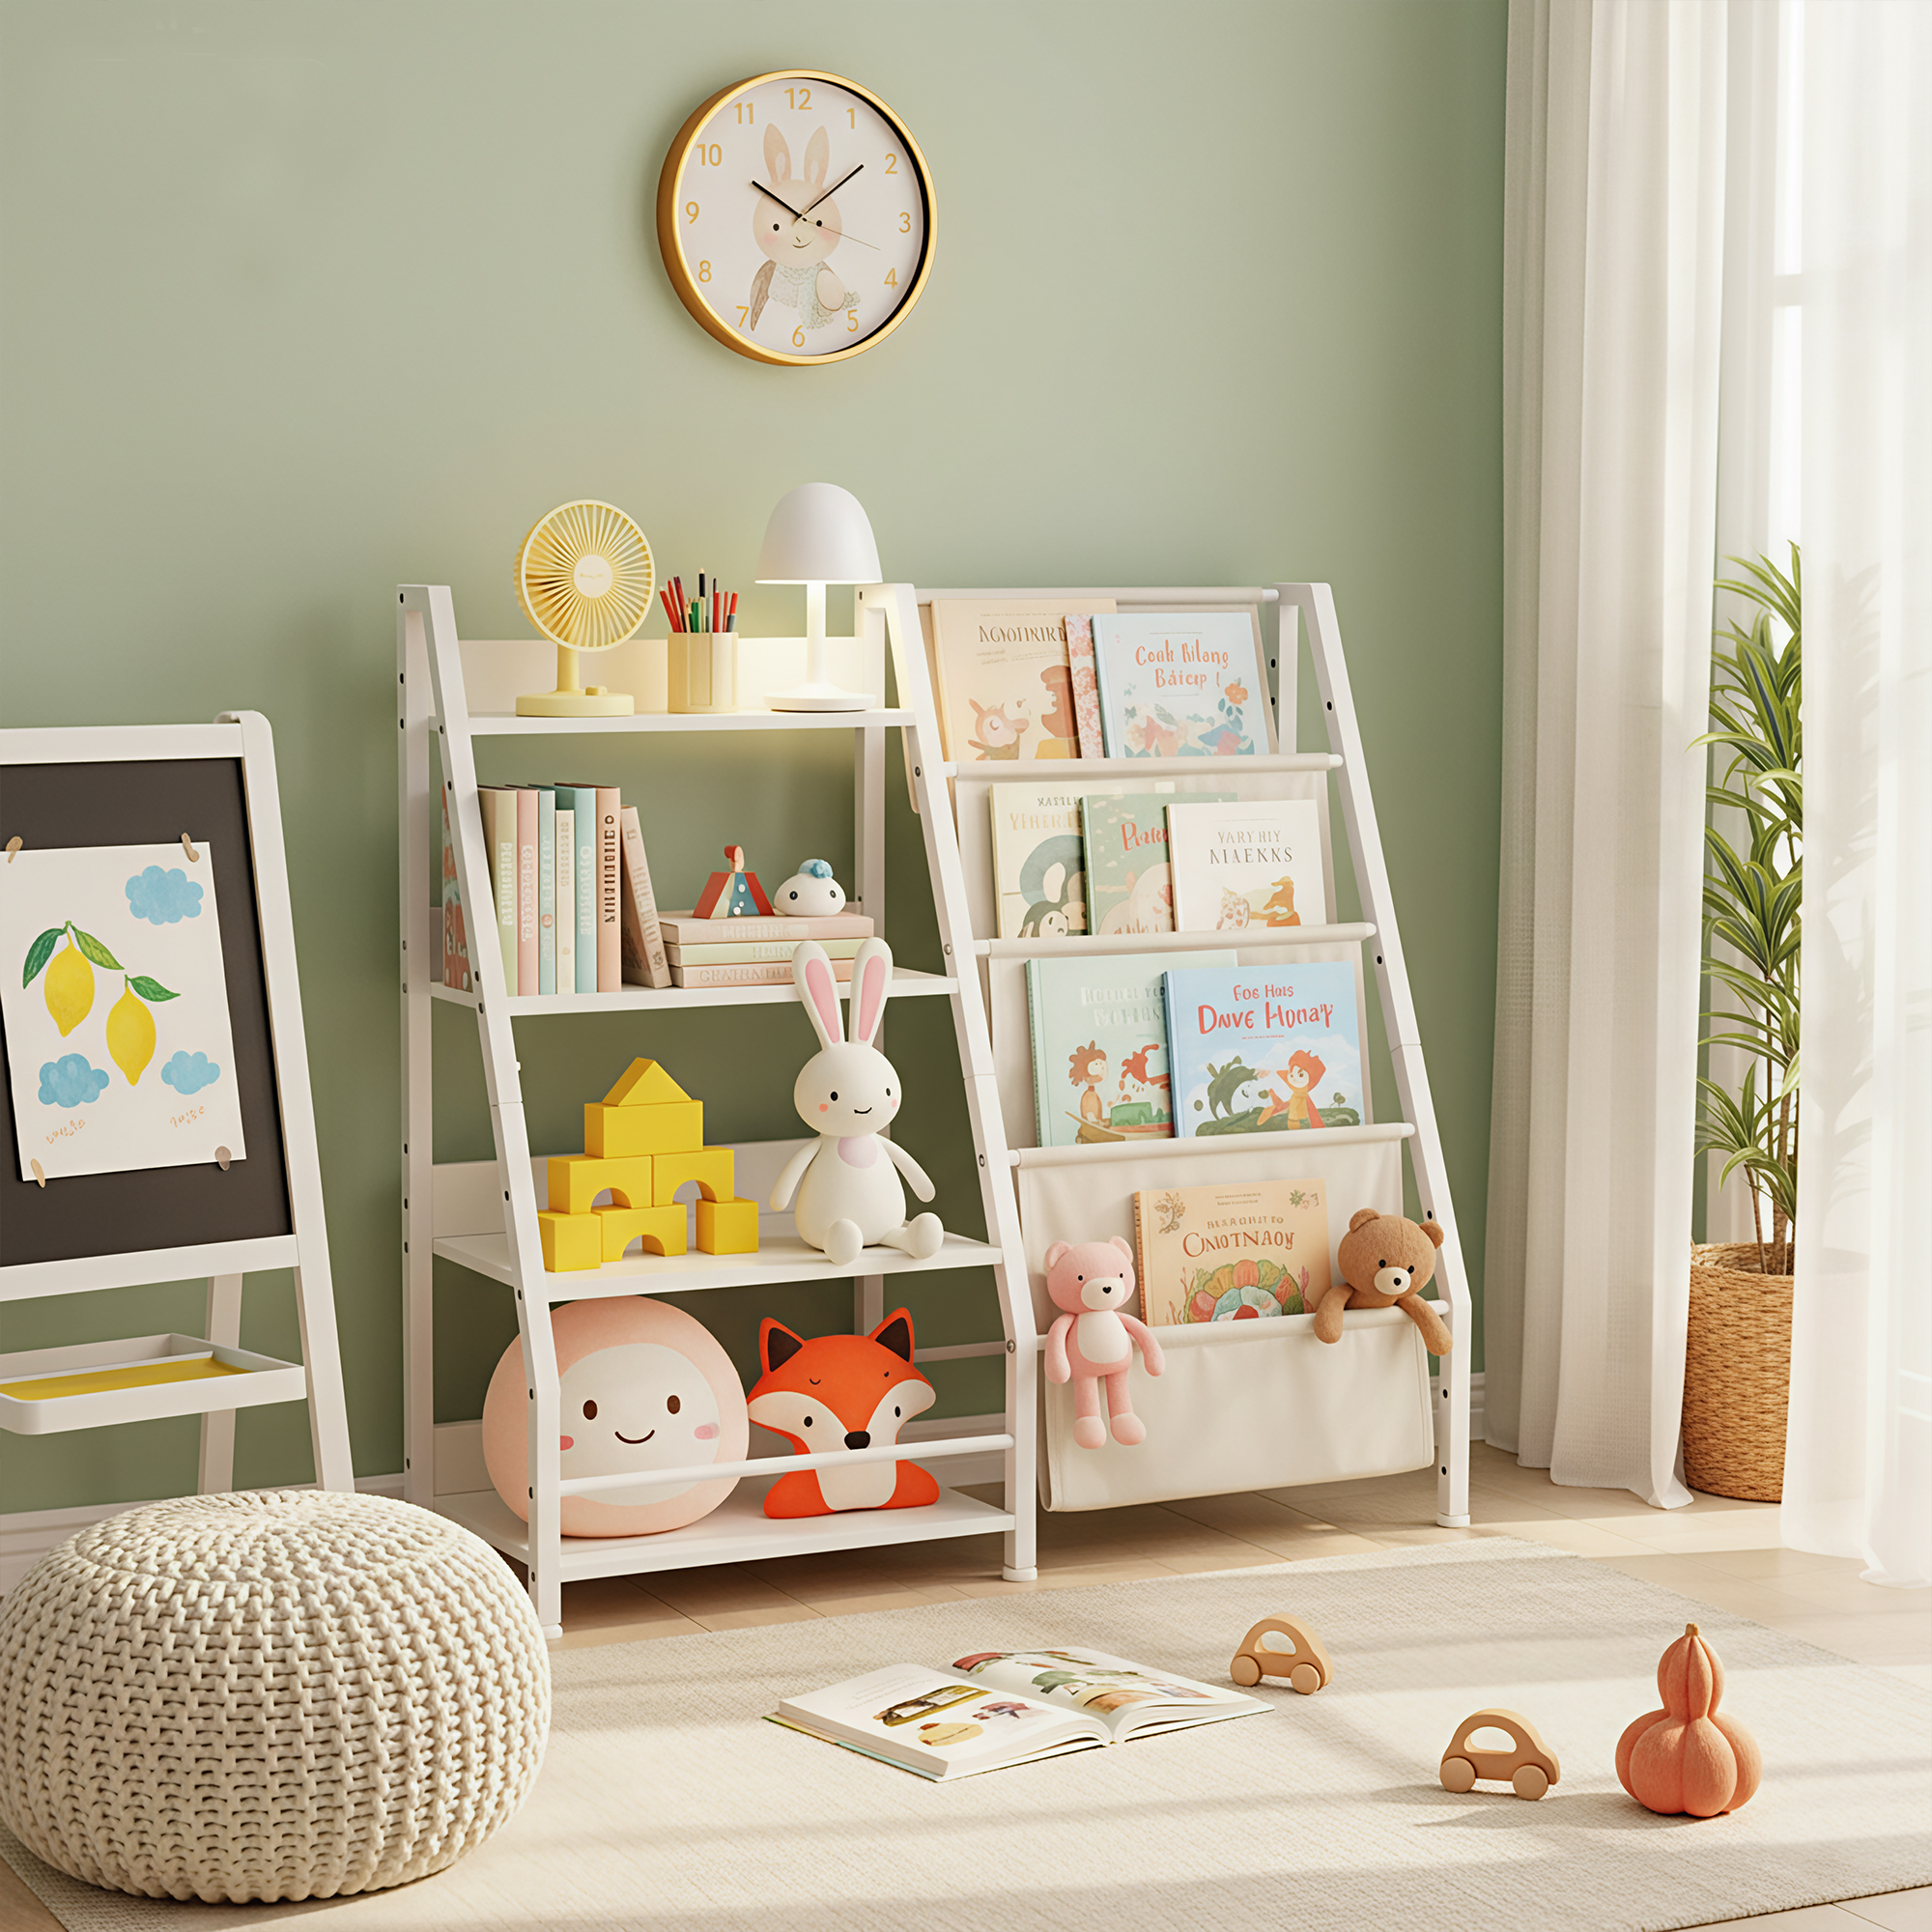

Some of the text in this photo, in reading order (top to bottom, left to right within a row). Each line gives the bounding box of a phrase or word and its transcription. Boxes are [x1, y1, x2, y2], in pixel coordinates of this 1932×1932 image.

[783, 88, 812, 110] 12
[734, 102, 753, 125] 11
[846, 107, 855, 129] 1
[696, 143, 722, 166] 10
[884, 153, 897, 174] 2
[686, 201, 699, 224] 9
[898, 212, 911, 233] 3
[698, 260, 712, 283] 8
[884, 268, 897, 289] 4
[736, 305, 750, 327] 7
[846, 309, 859, 332] 5
[792, 325, 806, 348] 6
